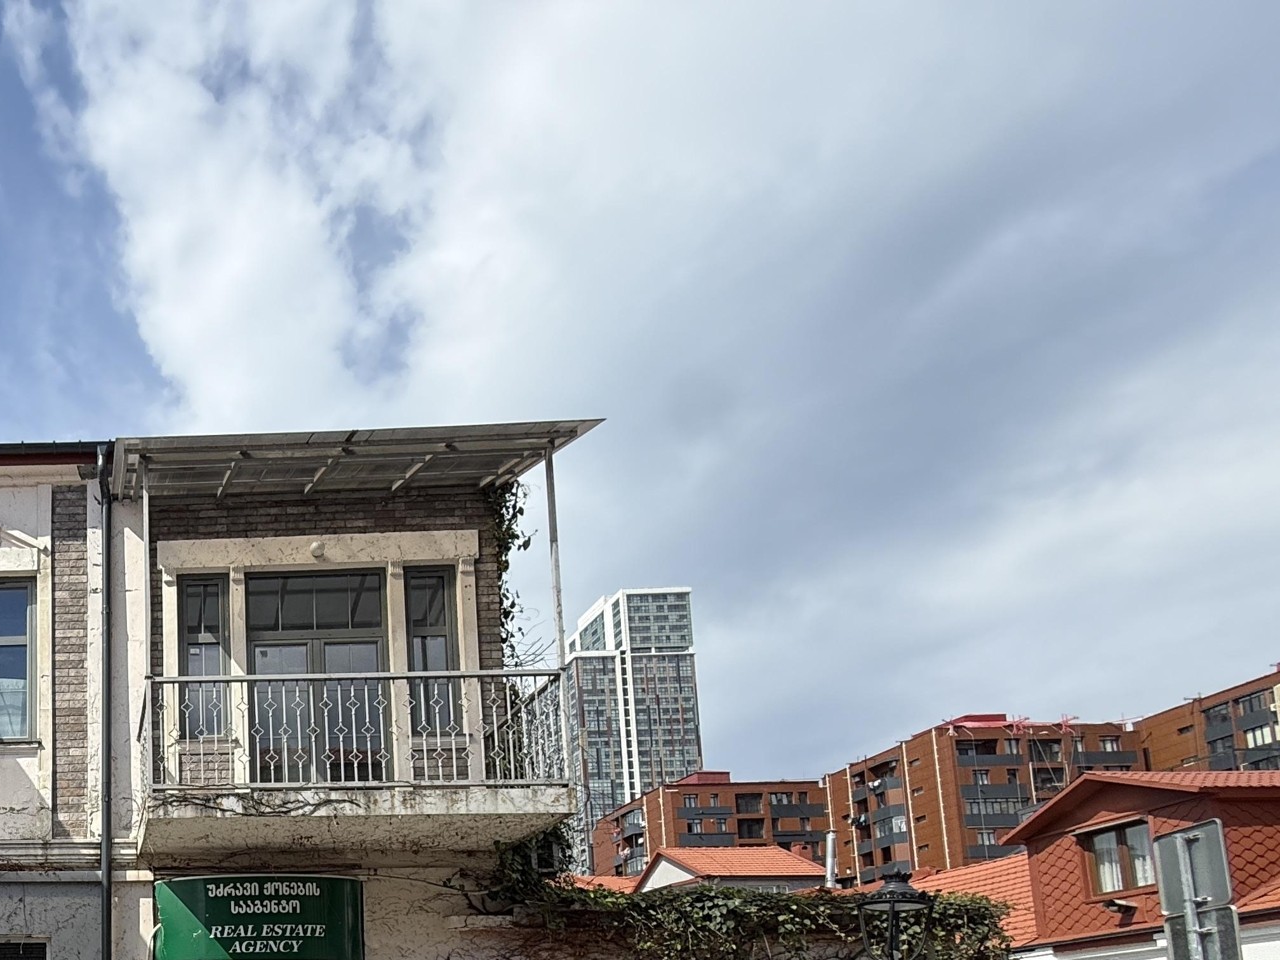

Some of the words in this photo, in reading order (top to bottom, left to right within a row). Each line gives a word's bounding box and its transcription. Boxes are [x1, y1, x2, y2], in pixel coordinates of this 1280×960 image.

[206, 882, 260, 898] უძრავი
[263, 881, 320, 897] ქონების
[230, 899, 301, 914] სააგენტო
[209, 925, 257, 939] REAL
[261, 924, 326, 938] ESTATE
[229, 940, 303, 954] AGENCY
